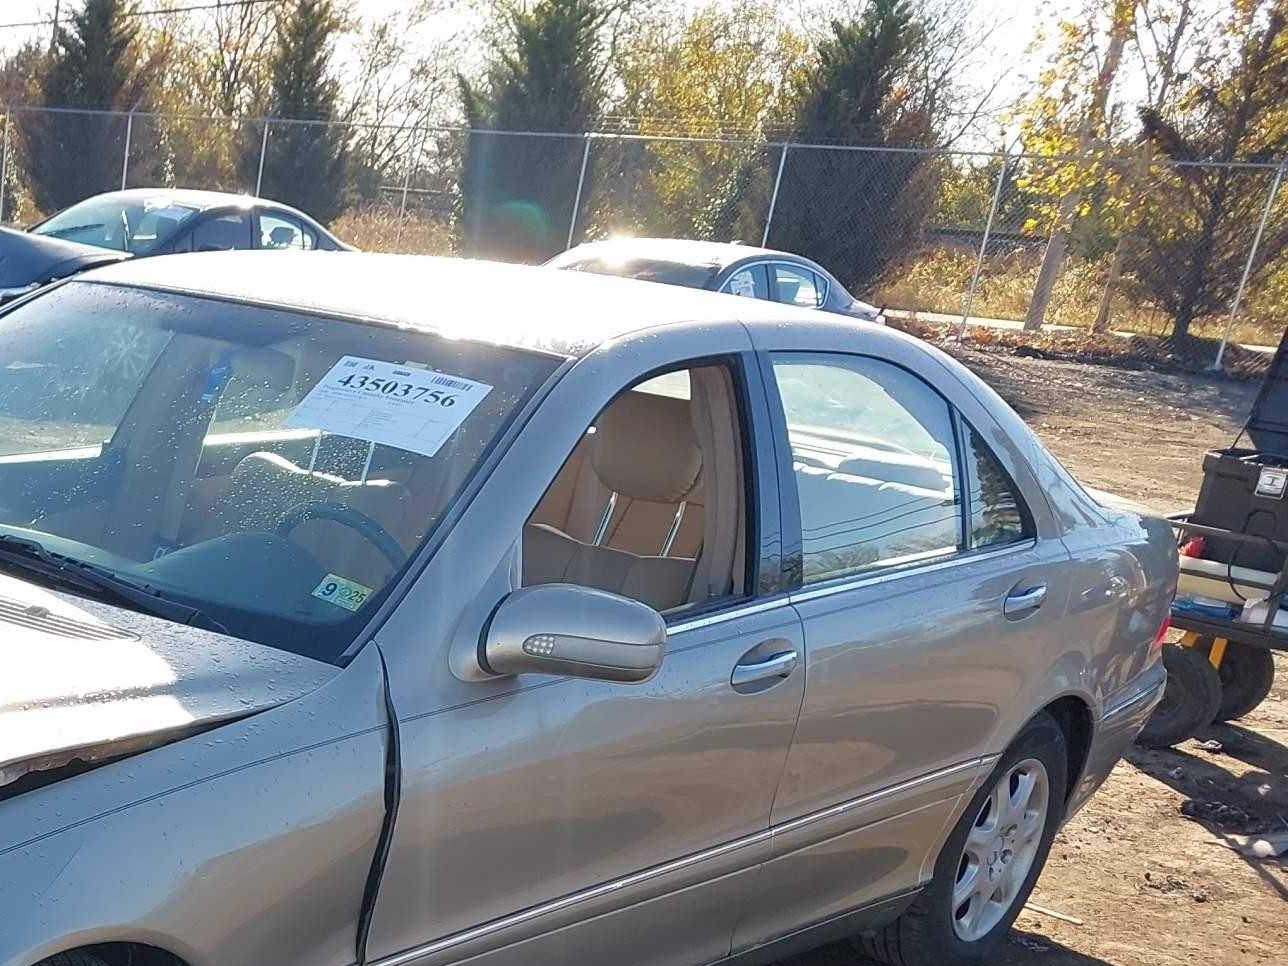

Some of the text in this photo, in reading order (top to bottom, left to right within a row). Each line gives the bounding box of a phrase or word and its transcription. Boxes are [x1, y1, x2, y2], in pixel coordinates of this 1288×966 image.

[337, 374, 459, 407] 43503756
[322, 582, 367, 603] 9 25
